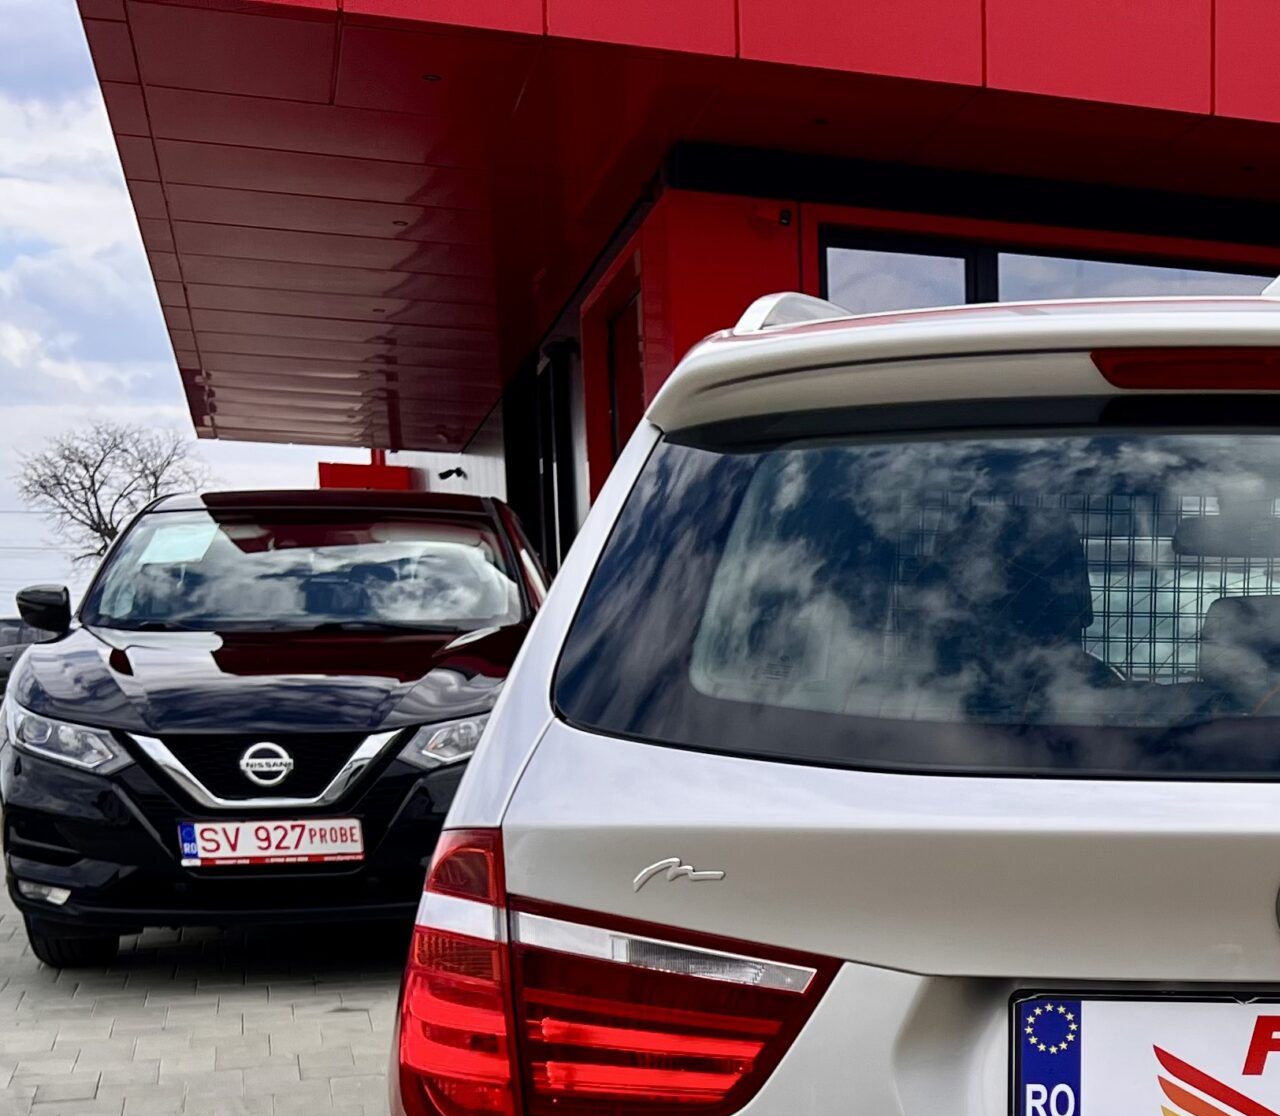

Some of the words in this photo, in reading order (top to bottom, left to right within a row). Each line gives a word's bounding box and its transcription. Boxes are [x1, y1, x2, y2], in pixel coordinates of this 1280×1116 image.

[245, 761, 292, 770] NISSAN
[199, 827, 240, 853] SV
[254, 824, 306, 851] 927
[308, 826, 359, 845] PROBE
[183, 842, 197, 854] RO
